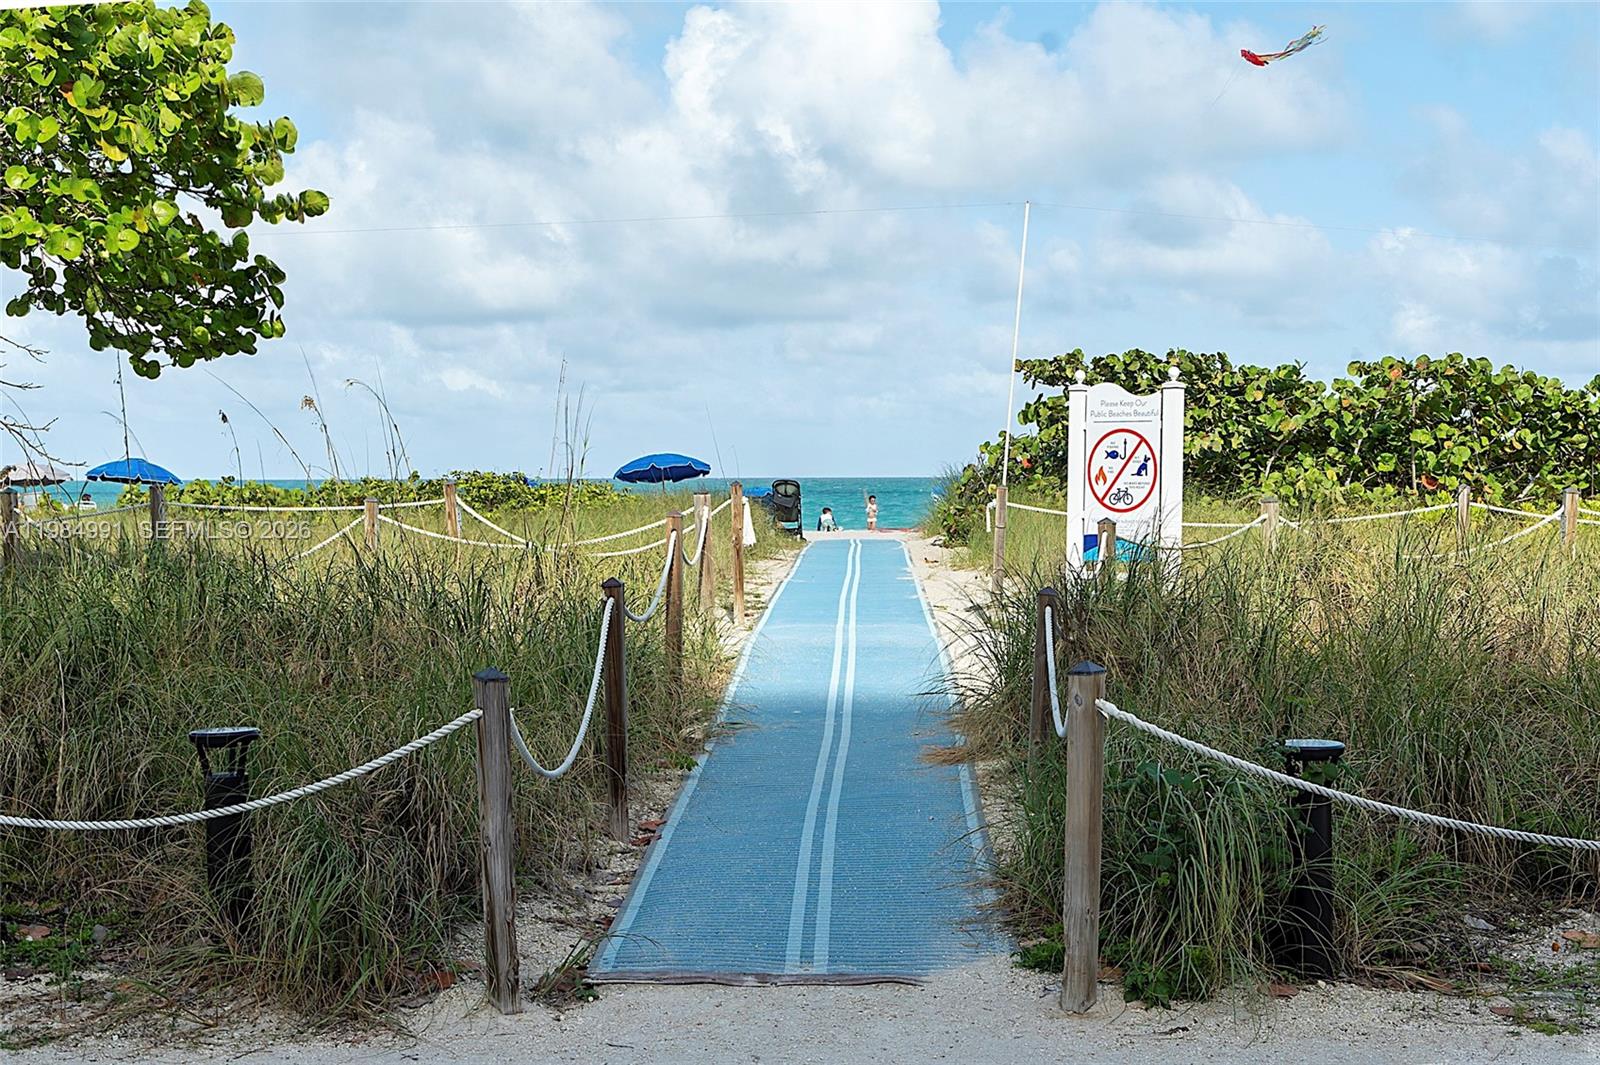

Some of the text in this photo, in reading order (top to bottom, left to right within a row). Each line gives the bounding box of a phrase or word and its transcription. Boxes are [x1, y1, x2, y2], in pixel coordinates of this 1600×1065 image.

[1120, 400, 1134, 408] Keep
[1135, 399, 1147, 407] Our
[1090, 408, 1159, 418] Public Beaches Beautiful
